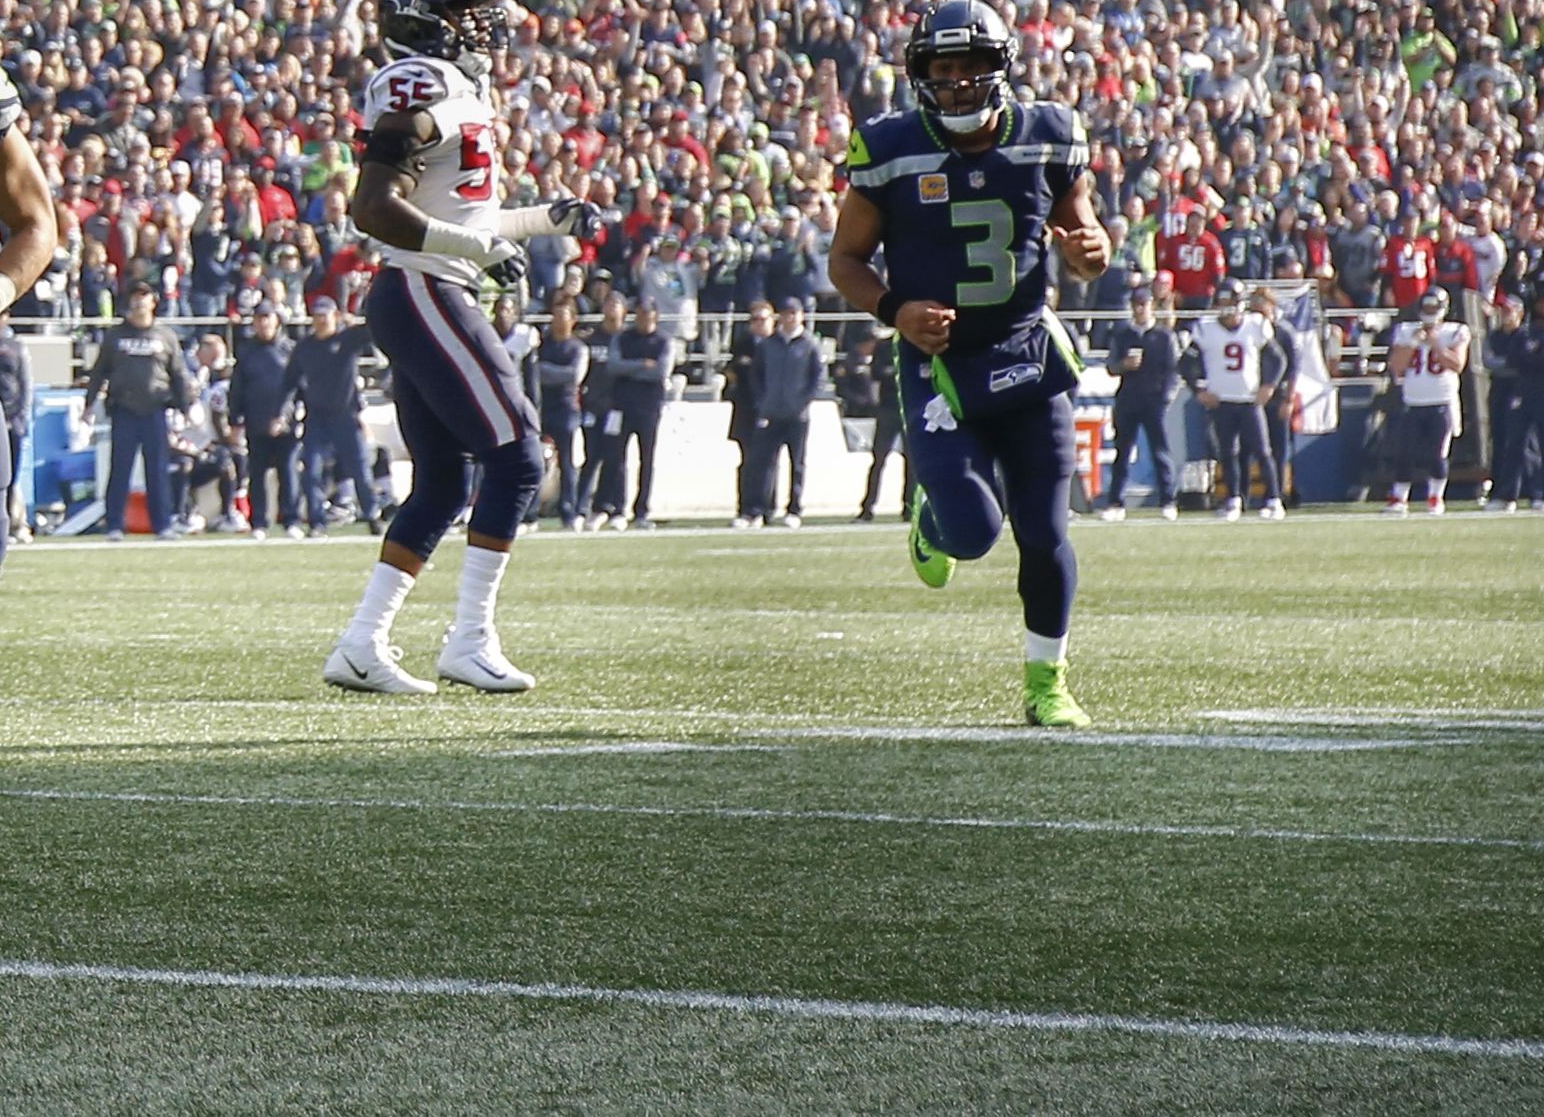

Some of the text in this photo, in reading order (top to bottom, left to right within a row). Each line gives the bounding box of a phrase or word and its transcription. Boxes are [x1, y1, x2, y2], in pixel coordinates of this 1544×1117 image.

[387, 77, 434, 111] 55
[457, 121, 497, 202] 5
[950, 198, 1016, 307] 3
[1224, 342, 1244, 372] 9
